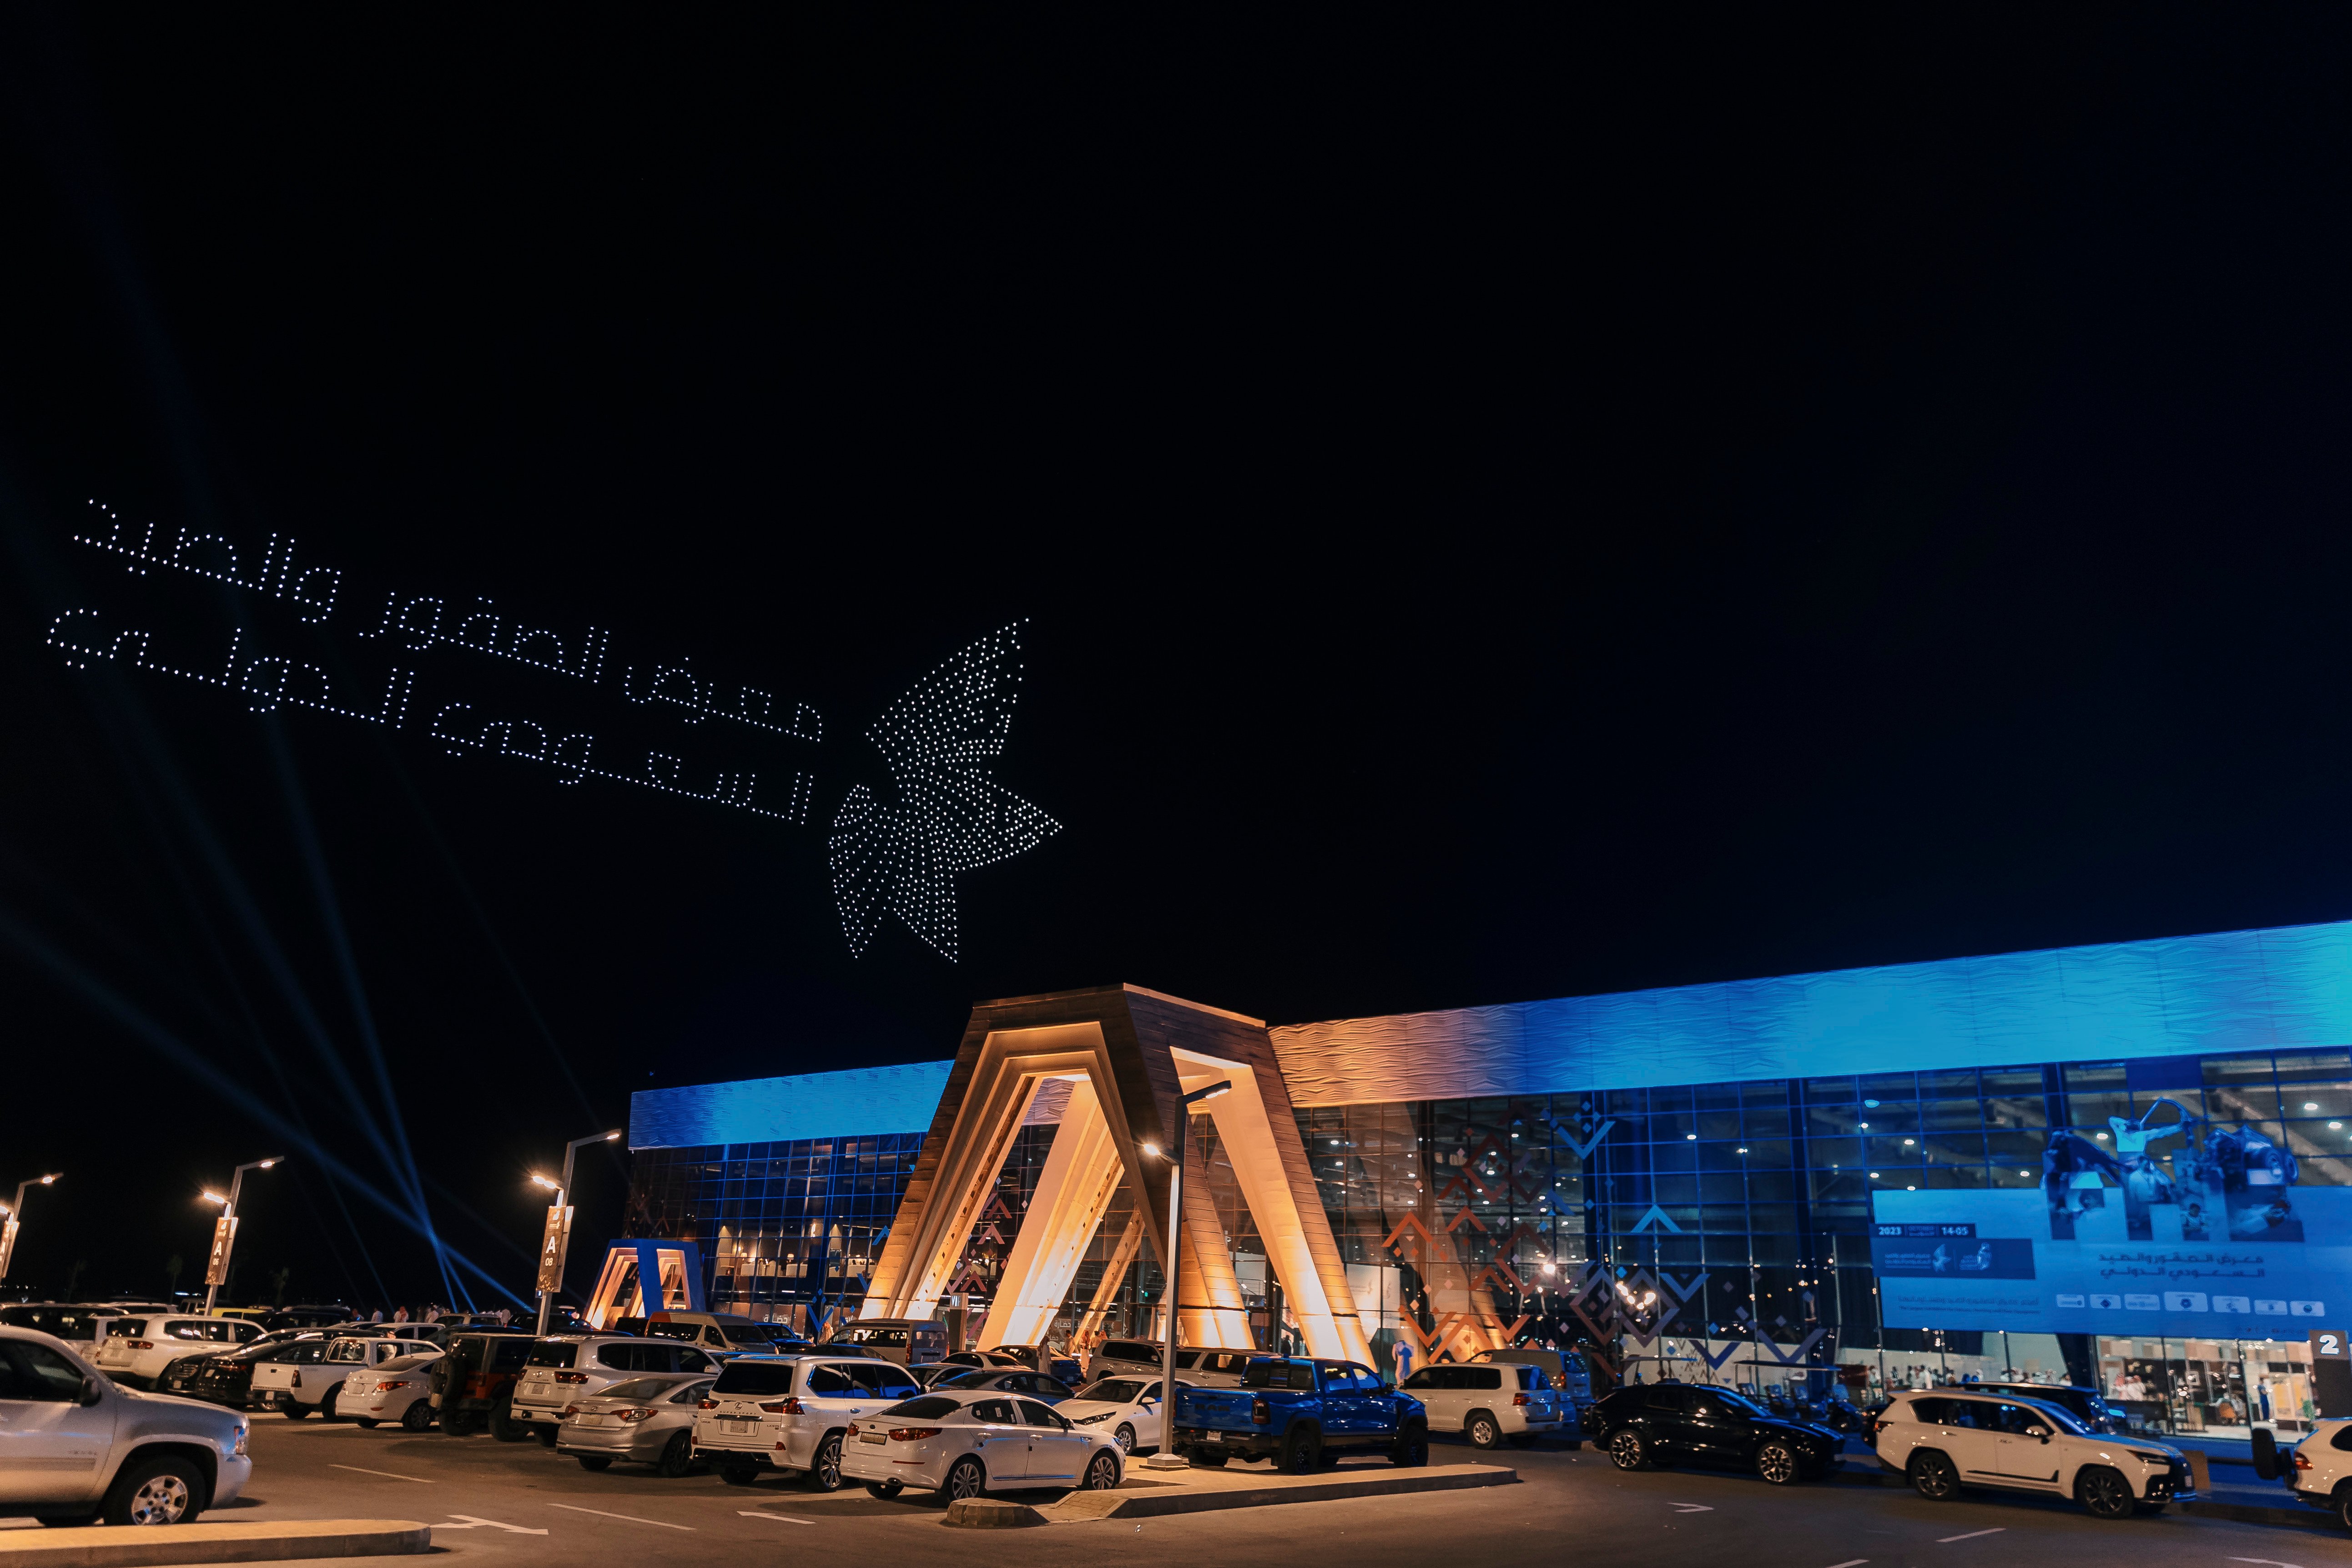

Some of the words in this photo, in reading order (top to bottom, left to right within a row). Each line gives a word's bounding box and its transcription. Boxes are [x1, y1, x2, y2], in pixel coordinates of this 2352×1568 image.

[74, 499, 341, 622] والصيد
[359, 592, 609, 683] الصقور
[47, 608, 413, 729] الدولي
[625, 657, 822, 743] معرض
[432, 703, 814, 825] السعودي
[1879, 1226, 1902, 1235] 2023
[214, 1241, 222, 1255] A
[546, 1236, 556, 1254] A
[545, 1257, 554, 1266] 08
[2099, 1252, 2152, 1265] والصيد
[2155, 1251, 2213, 1265] الصقور
[2216, 1253, 2264, 1265] معرض
[764, 1314, 788, 1324] حضاة
[2320, 1335, 2339, 1355] 2
